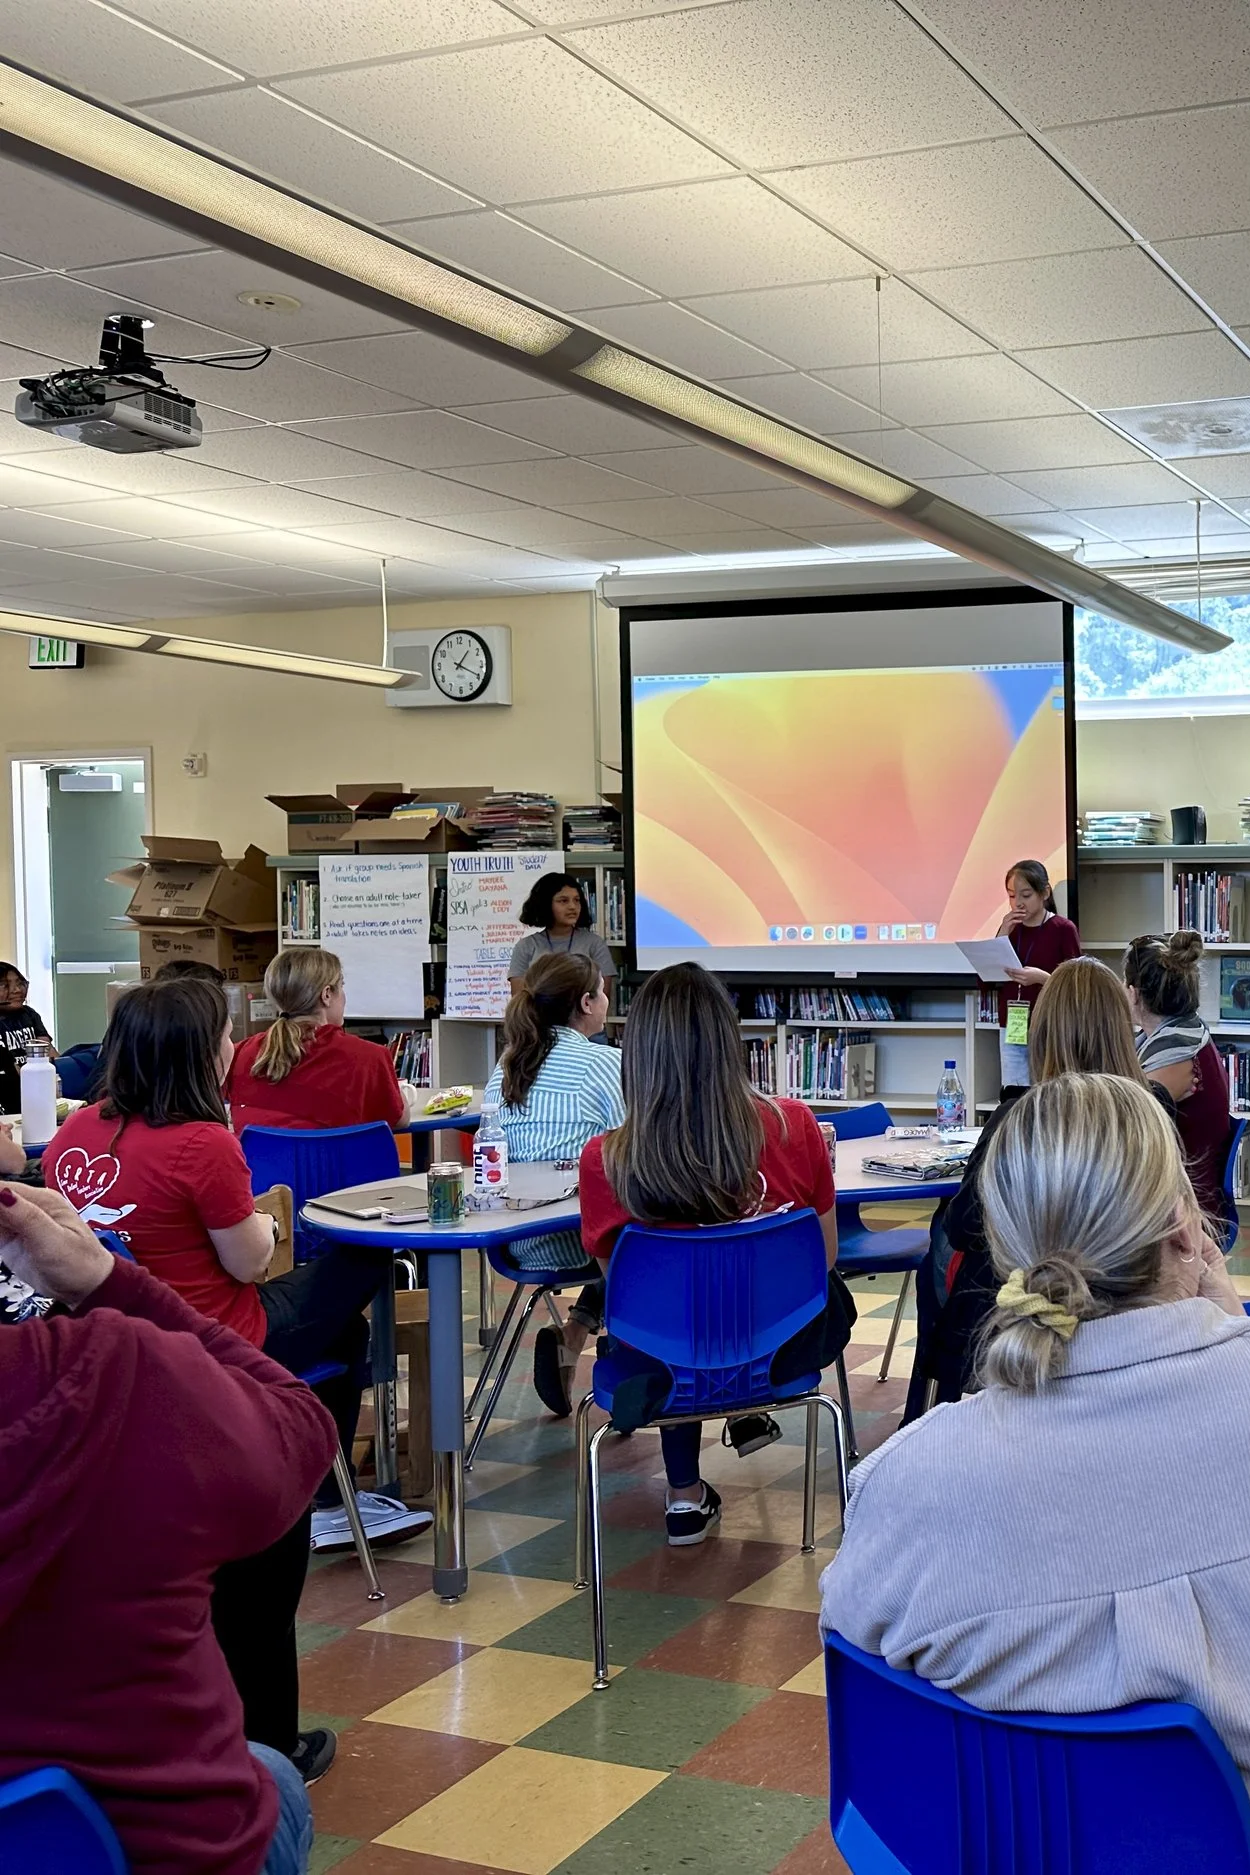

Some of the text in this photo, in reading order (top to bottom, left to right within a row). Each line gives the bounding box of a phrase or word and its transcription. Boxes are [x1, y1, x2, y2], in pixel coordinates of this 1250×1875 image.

[440, 650, 446, 658] 10
[476, 648, 479, 656] 2
[480, 660, 483, 668] 3
[441, 675, 445, 683] 8
[449, 683, 453, 691] 7
[451, 857, 481, 871] YOUTH
[484, 856, 513, 870] TRUTH
